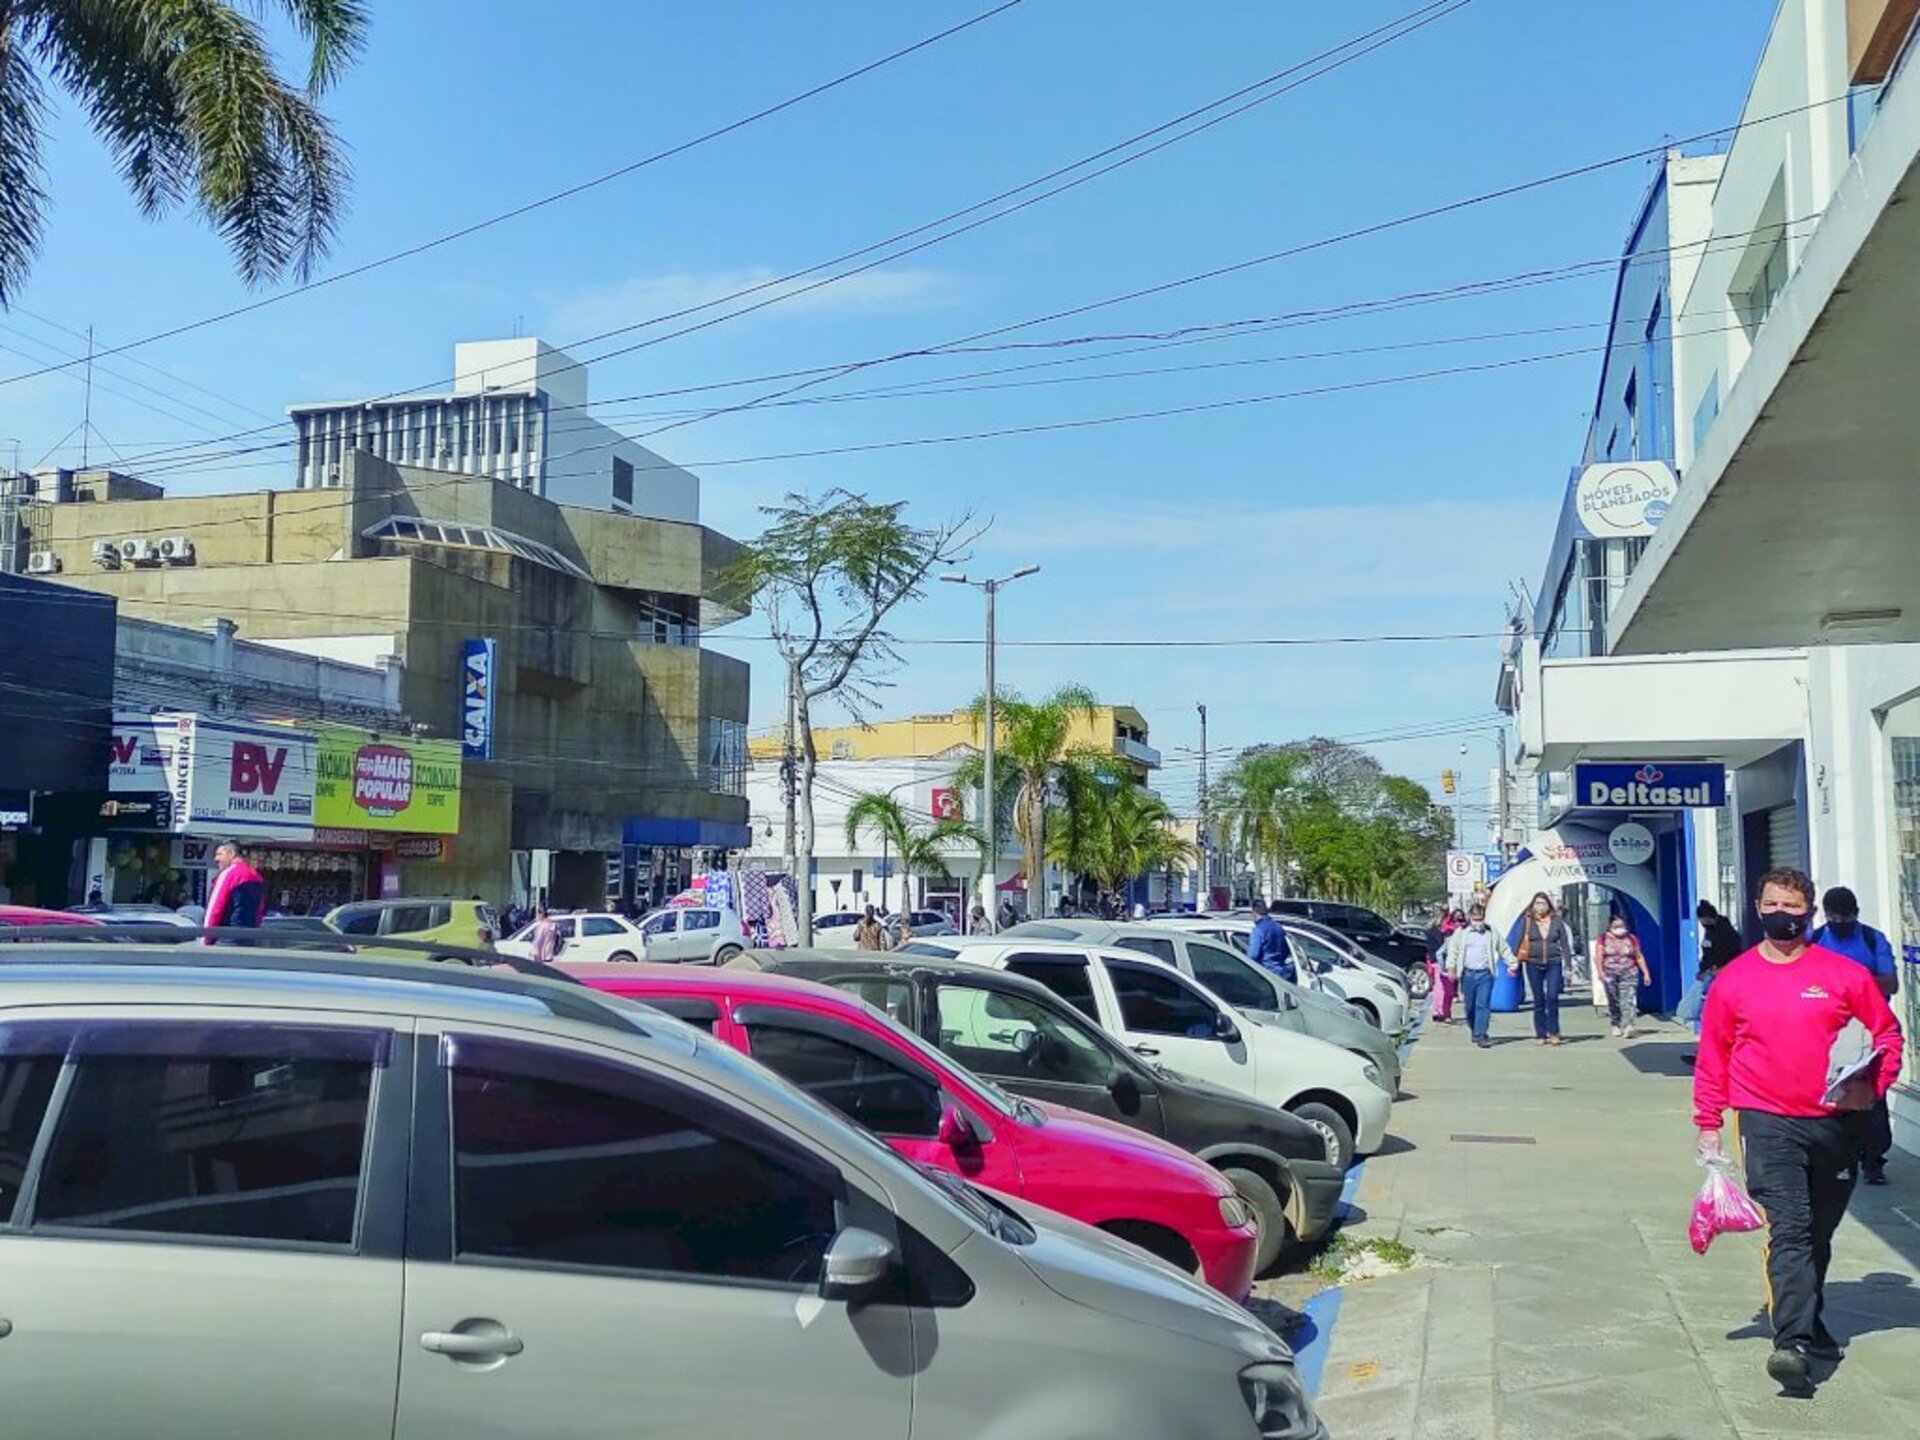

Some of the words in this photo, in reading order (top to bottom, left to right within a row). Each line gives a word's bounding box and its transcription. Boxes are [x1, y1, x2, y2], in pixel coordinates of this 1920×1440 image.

[1583, 484, 1633, 501] MÓVEIS
[1584, 487, 1670, 513] PLANEJADOS
[465, 652, 487, 747] CAIXA
[229, 740, 288, 796] BV
[374, 754, 412, 779] MAIS
[174, 735, 191, 825] FINANCEIRA
[355, 778, 411, 801] POPULAR
[228, 797, 284, 813] FINANCEIRA
[1590, 781, 1709, 805] Deltasul
[1456, 859, 1464, 872] E
